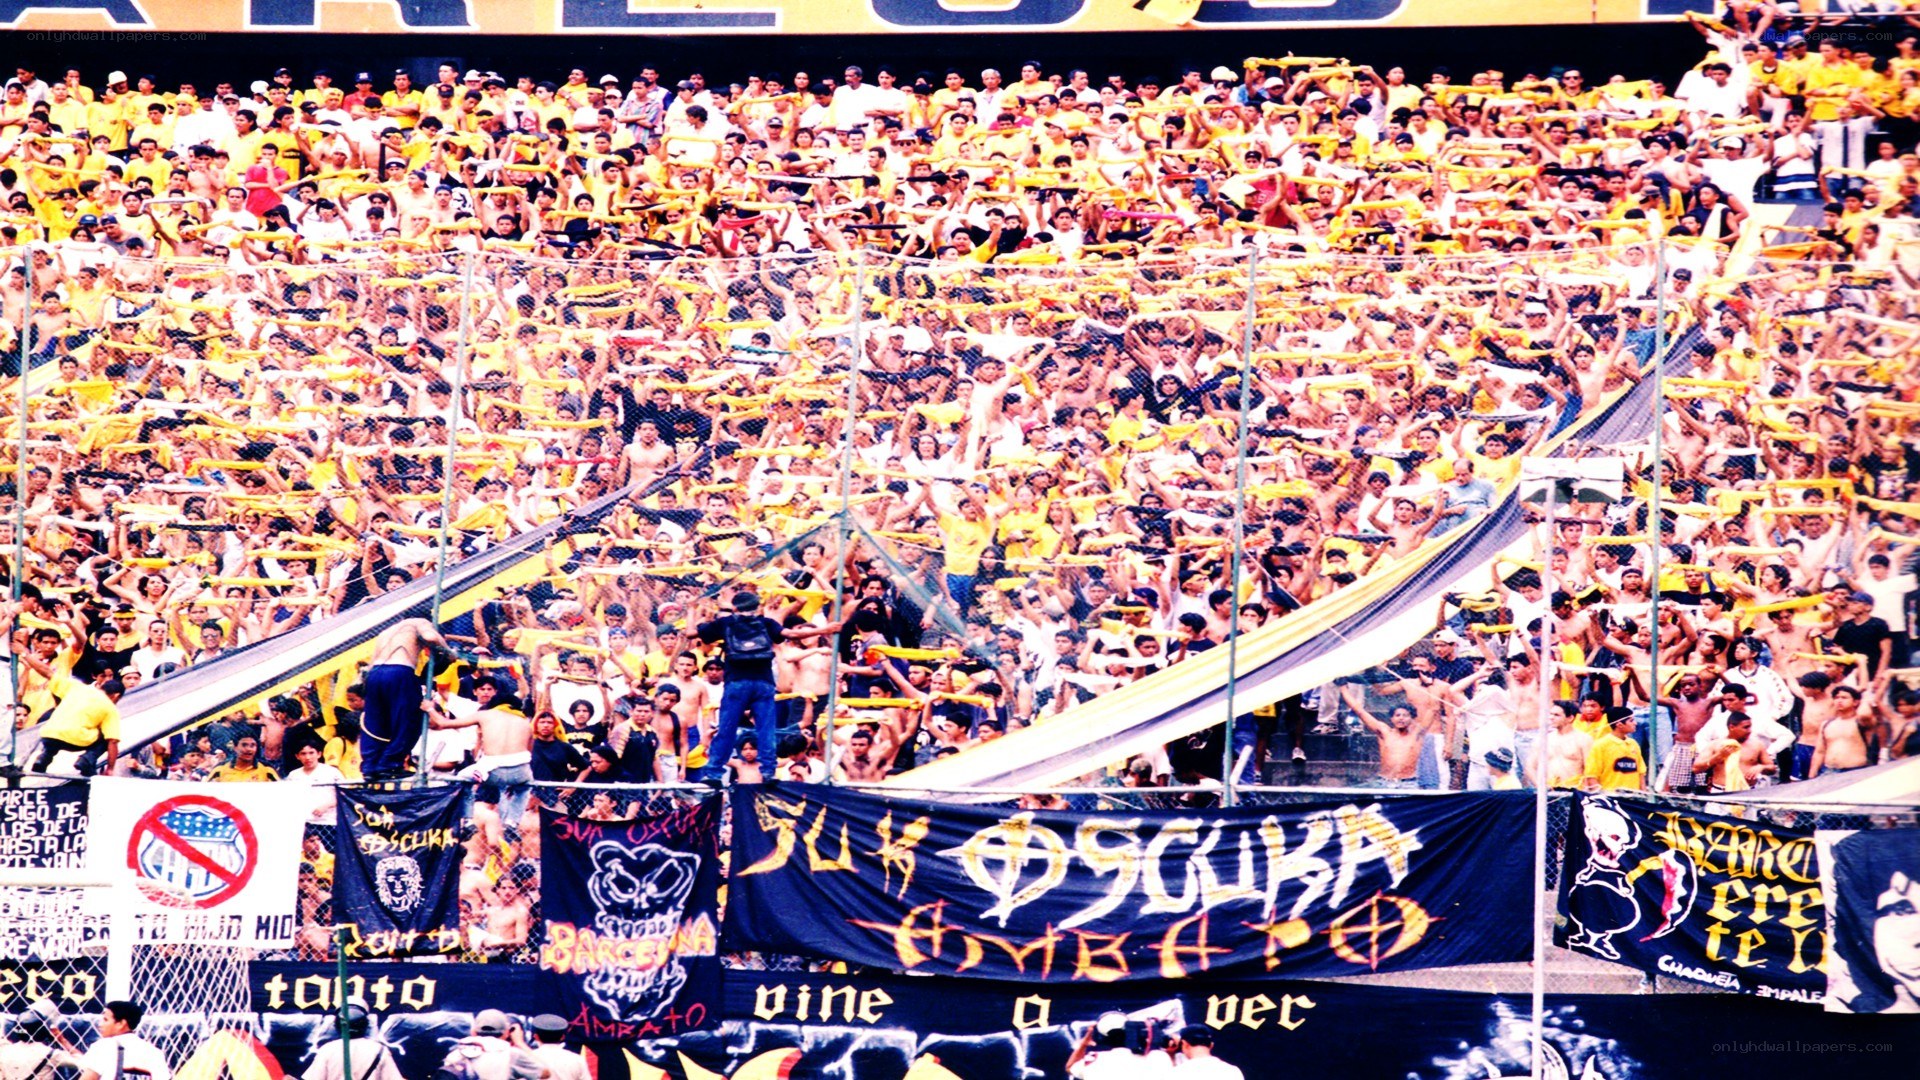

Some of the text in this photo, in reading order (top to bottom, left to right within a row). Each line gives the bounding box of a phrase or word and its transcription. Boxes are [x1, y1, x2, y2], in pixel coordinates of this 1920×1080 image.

[4, 802, 82, 822] SIGO DE
[42, 819, 65, 837] DE
[935, 802, 1424, 928] OSCURA
[753, 983, 894, 1024] vine
[1012, 994, 1051, 1031] a
[1205, 993, 1316, 1031] ver
